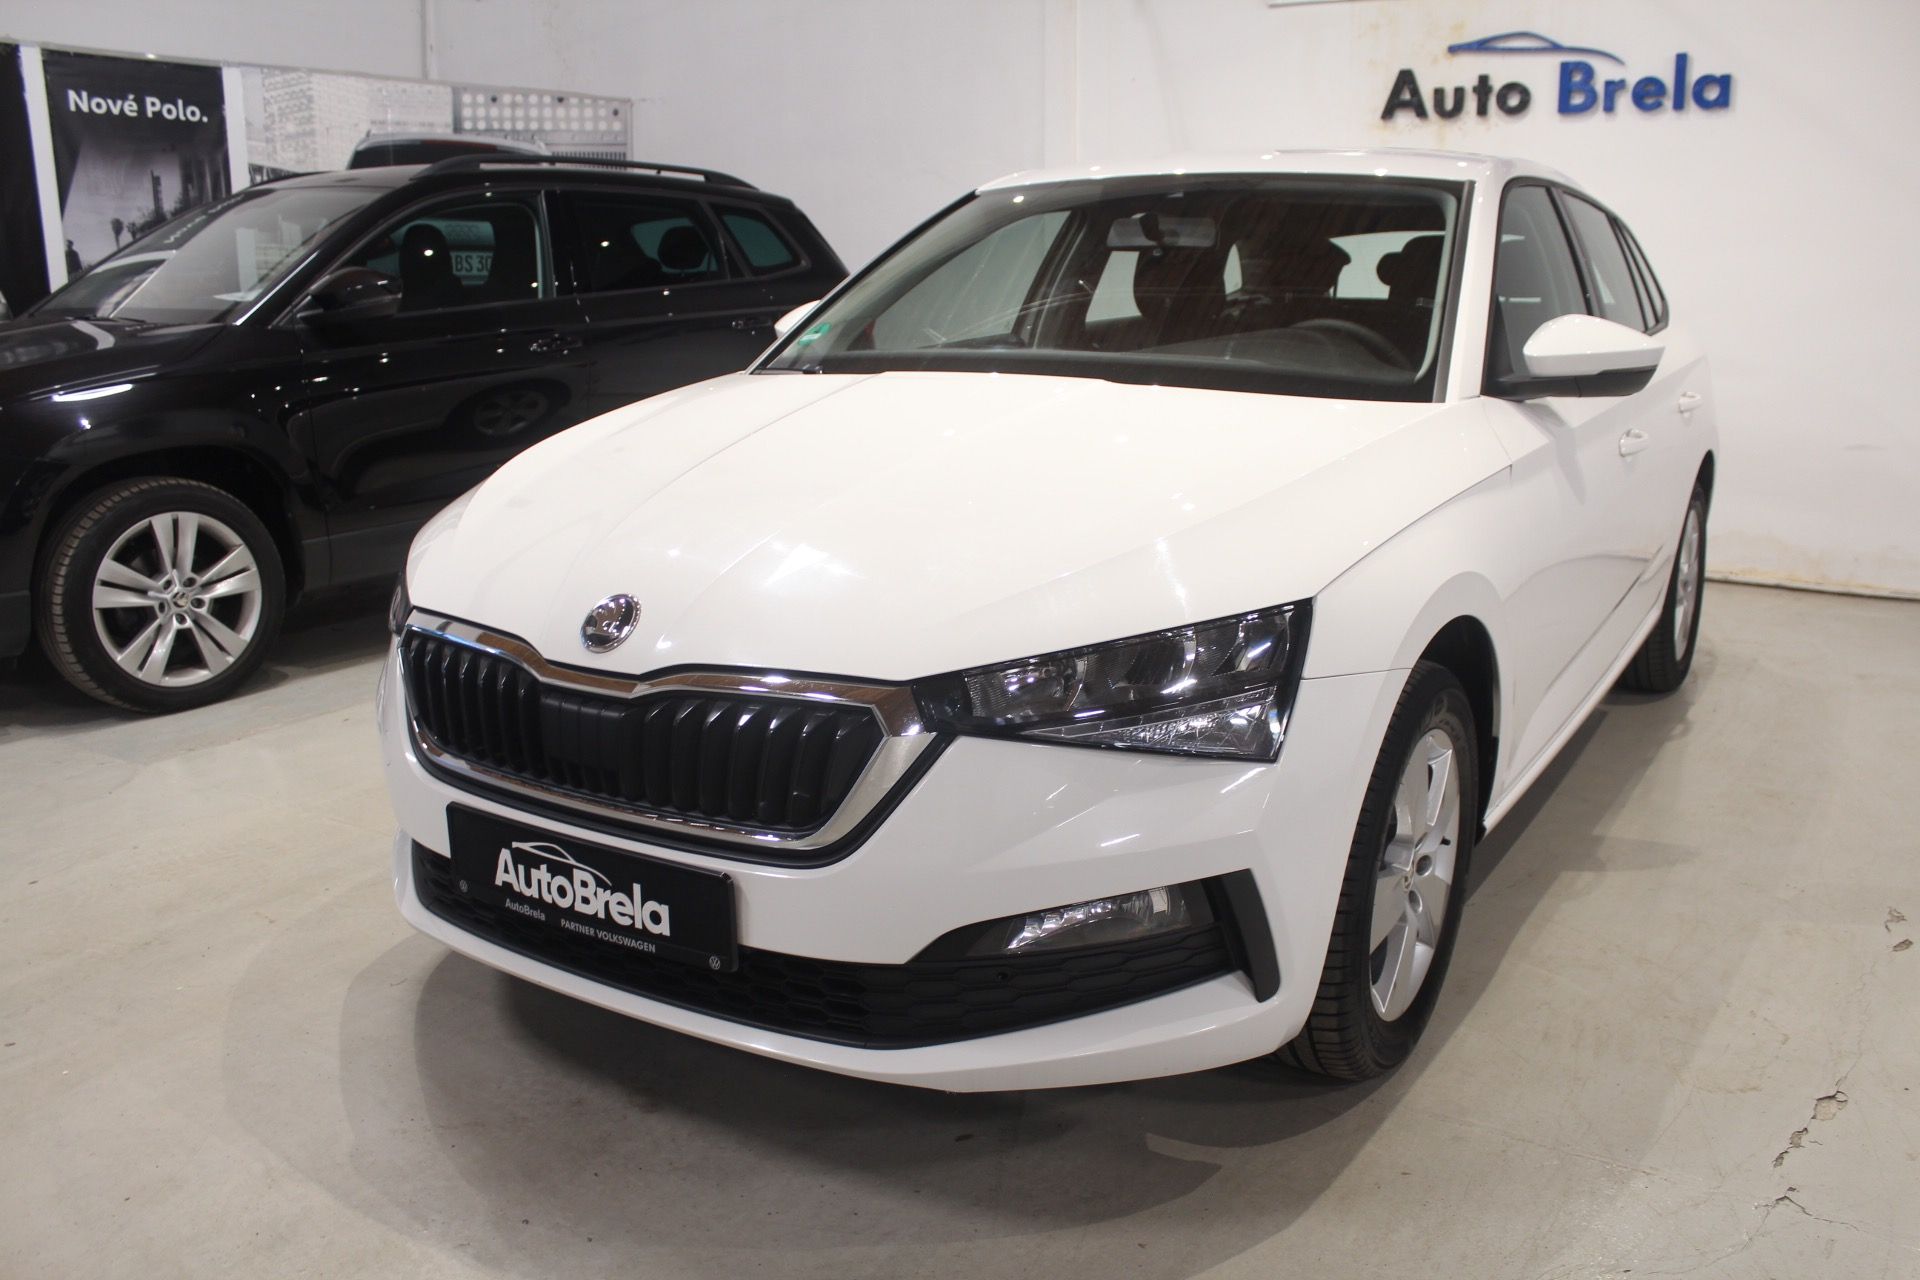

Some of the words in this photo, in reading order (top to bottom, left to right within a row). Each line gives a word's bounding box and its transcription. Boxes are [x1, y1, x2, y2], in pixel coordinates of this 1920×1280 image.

[1380, 68, 1532, 121] Auto
[1558, 53, 1732, 114] Brela
[67, 89, 139, 118] Nové
[145, 96, 209, 123] Polo.
[494, 846, 671, 937] AutoBrela
[505, 898, 546, 922] AutoBrela
[560, 917, 596, 937] PARTNER
[596, 929, 657, 954] VOLKSWAGEN
